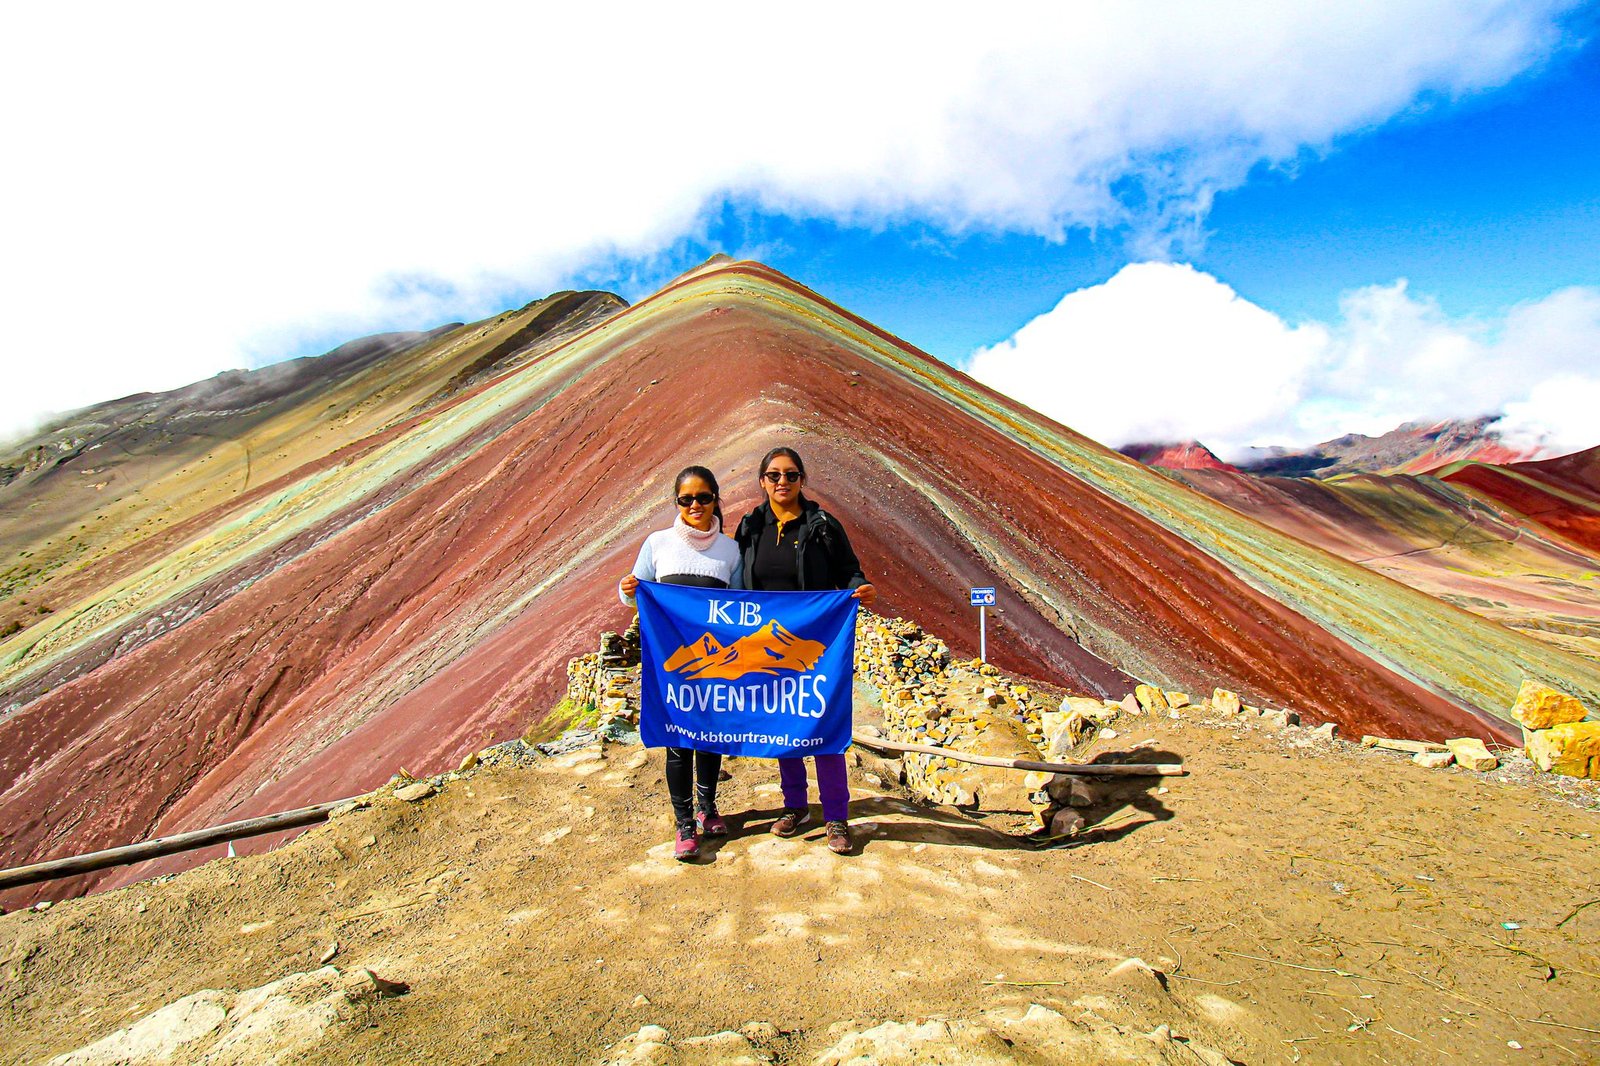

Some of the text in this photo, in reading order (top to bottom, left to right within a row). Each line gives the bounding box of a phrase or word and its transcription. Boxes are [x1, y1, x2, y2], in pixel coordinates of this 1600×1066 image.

[707, 599, 762, 626] KB
[666, 674, 827, 718] ADVENTURES
[665, 723, 824, 748] www.kbtourtravel.com
